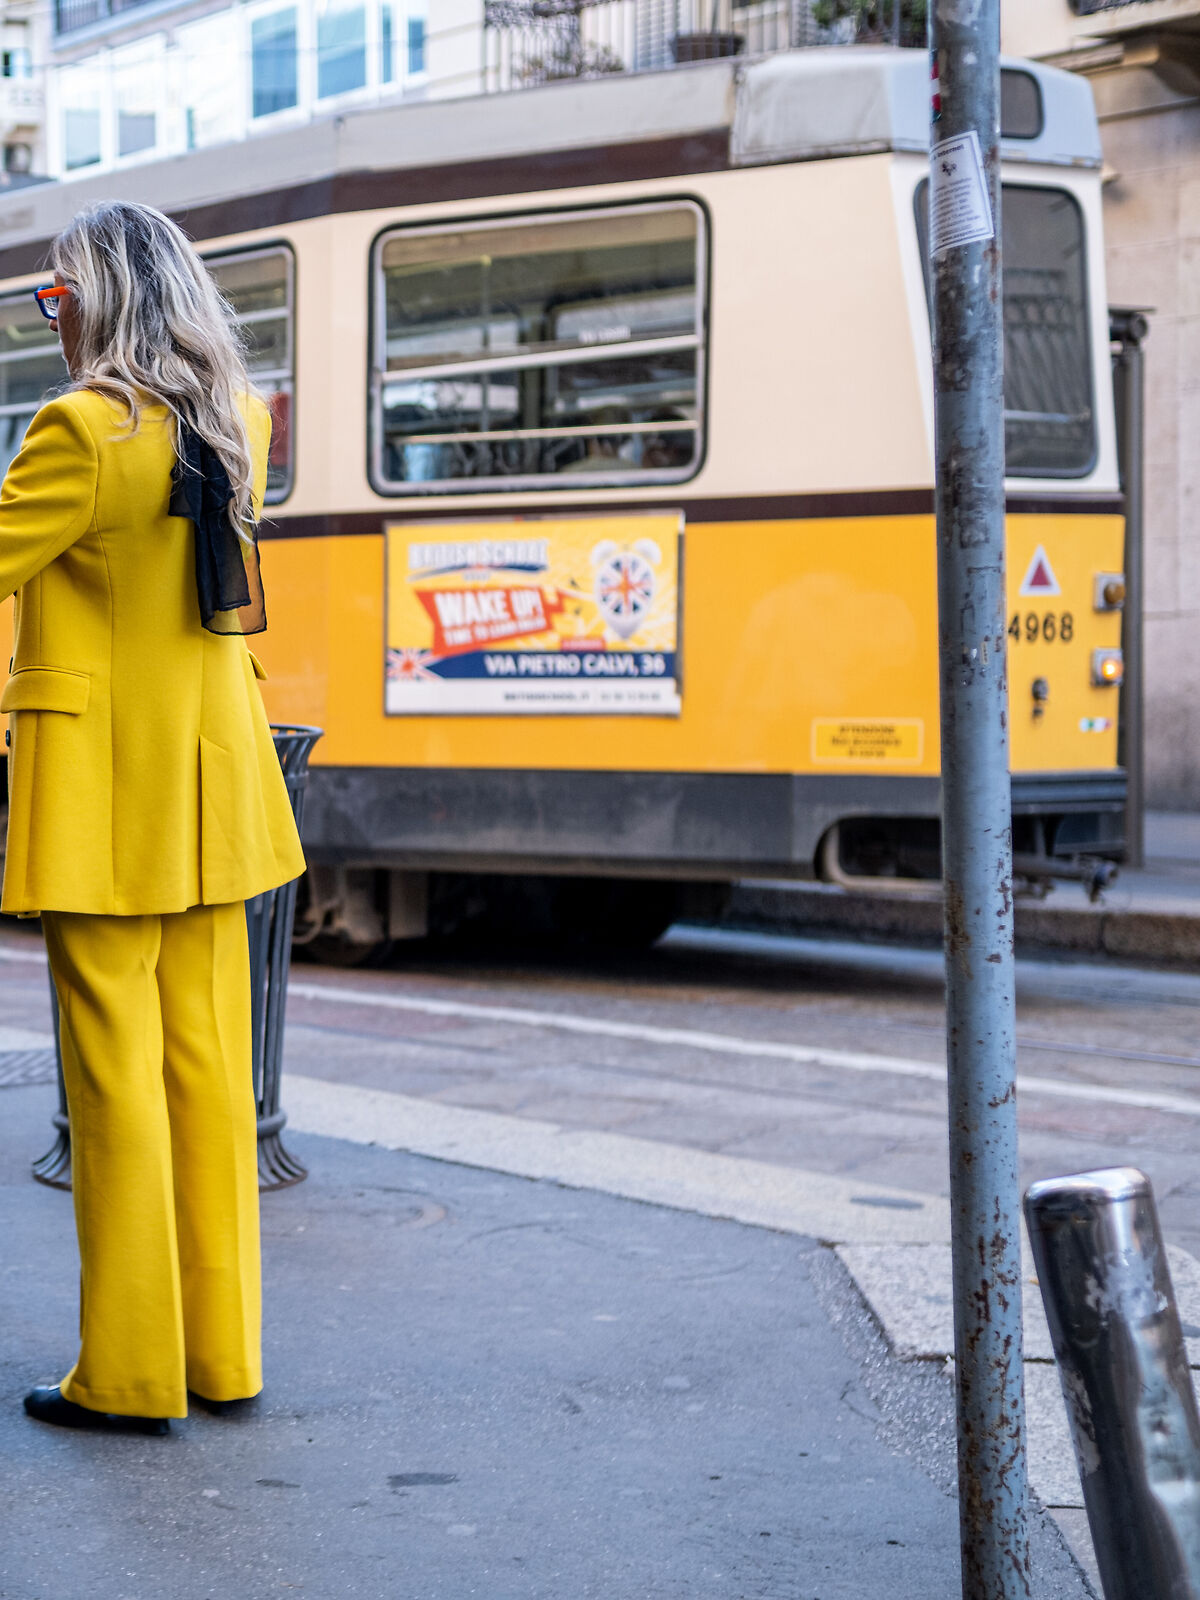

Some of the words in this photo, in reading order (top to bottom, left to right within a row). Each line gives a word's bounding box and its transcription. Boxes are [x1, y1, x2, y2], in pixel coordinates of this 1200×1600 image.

[434, 590, 510, 628] WAKE
[510, 589, 543, 618] UP!
[1007, 611, 1074, 644] 4968
[484, 654, 517, 675] VIA
[518, 653, 580, 675] PIETRO
[582, 653, 639, 677] CALVI,
